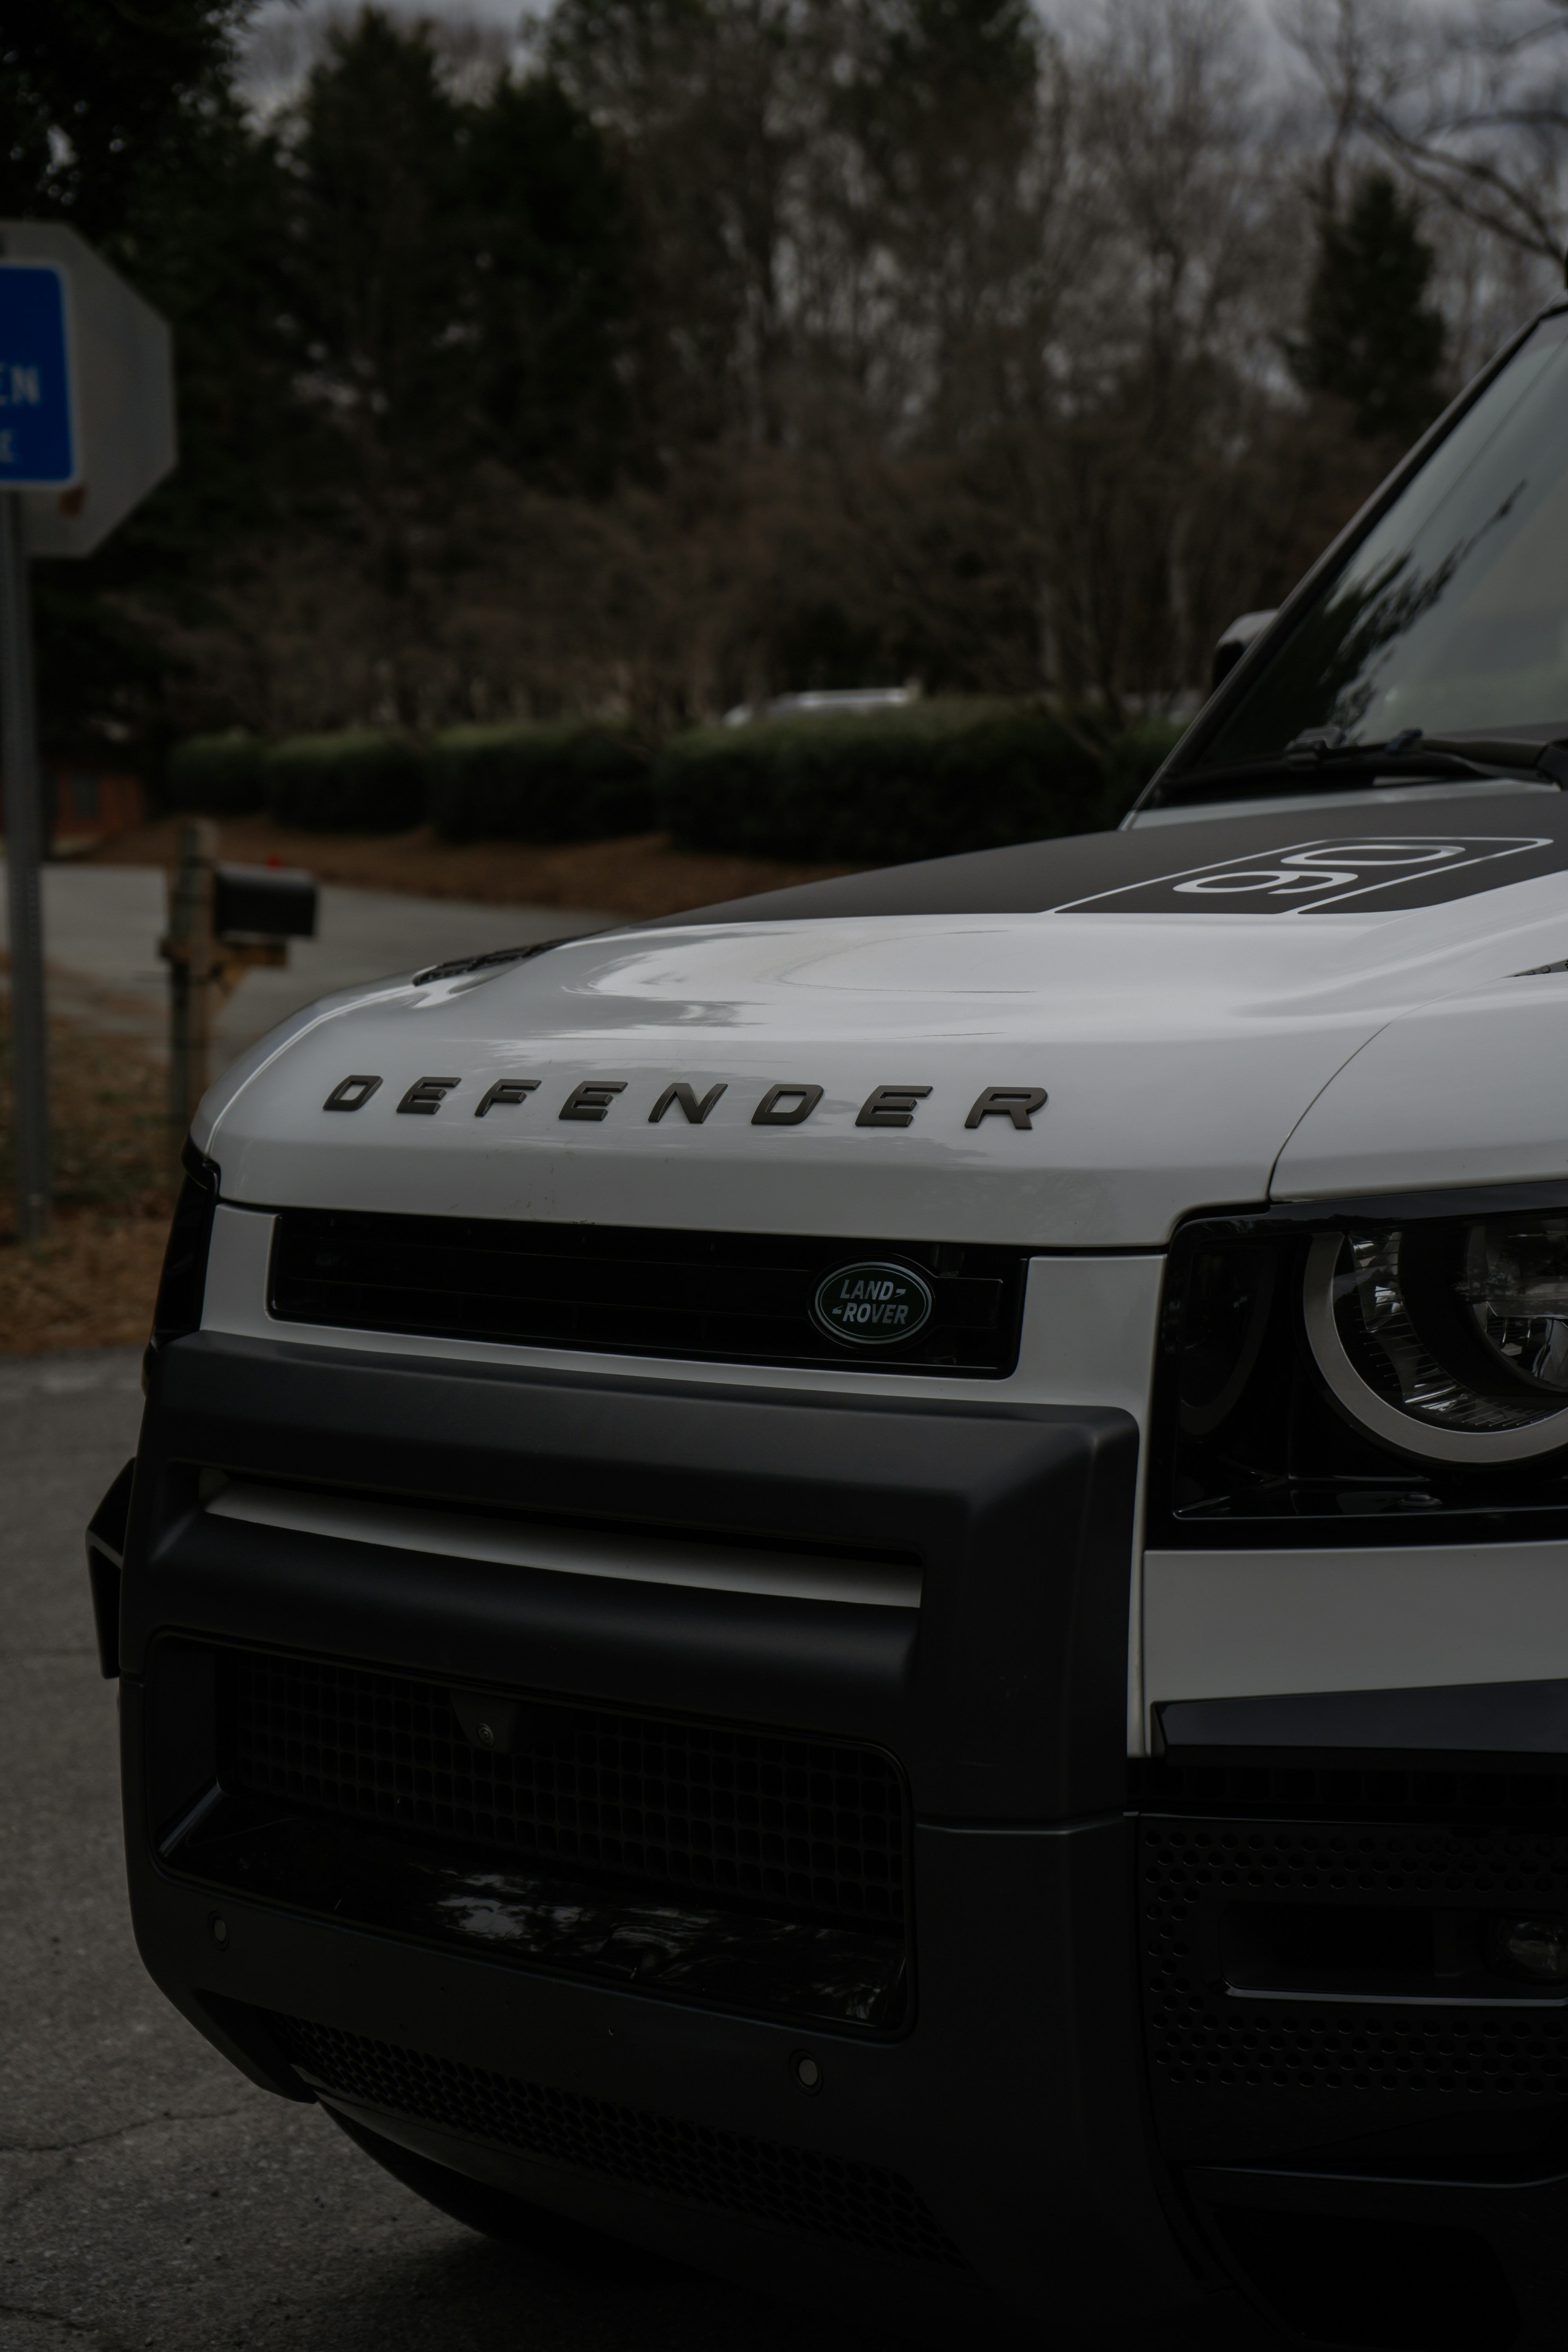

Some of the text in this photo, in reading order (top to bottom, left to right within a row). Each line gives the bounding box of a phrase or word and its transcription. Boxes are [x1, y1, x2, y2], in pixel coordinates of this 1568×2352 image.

[1173, 845, 1466, 894] 90
[323, 1075, 1047, 1129] DEFENDER
[840, 1279, 894, 1301] LAND
[842, 1302, 908, 1324] ROVER
